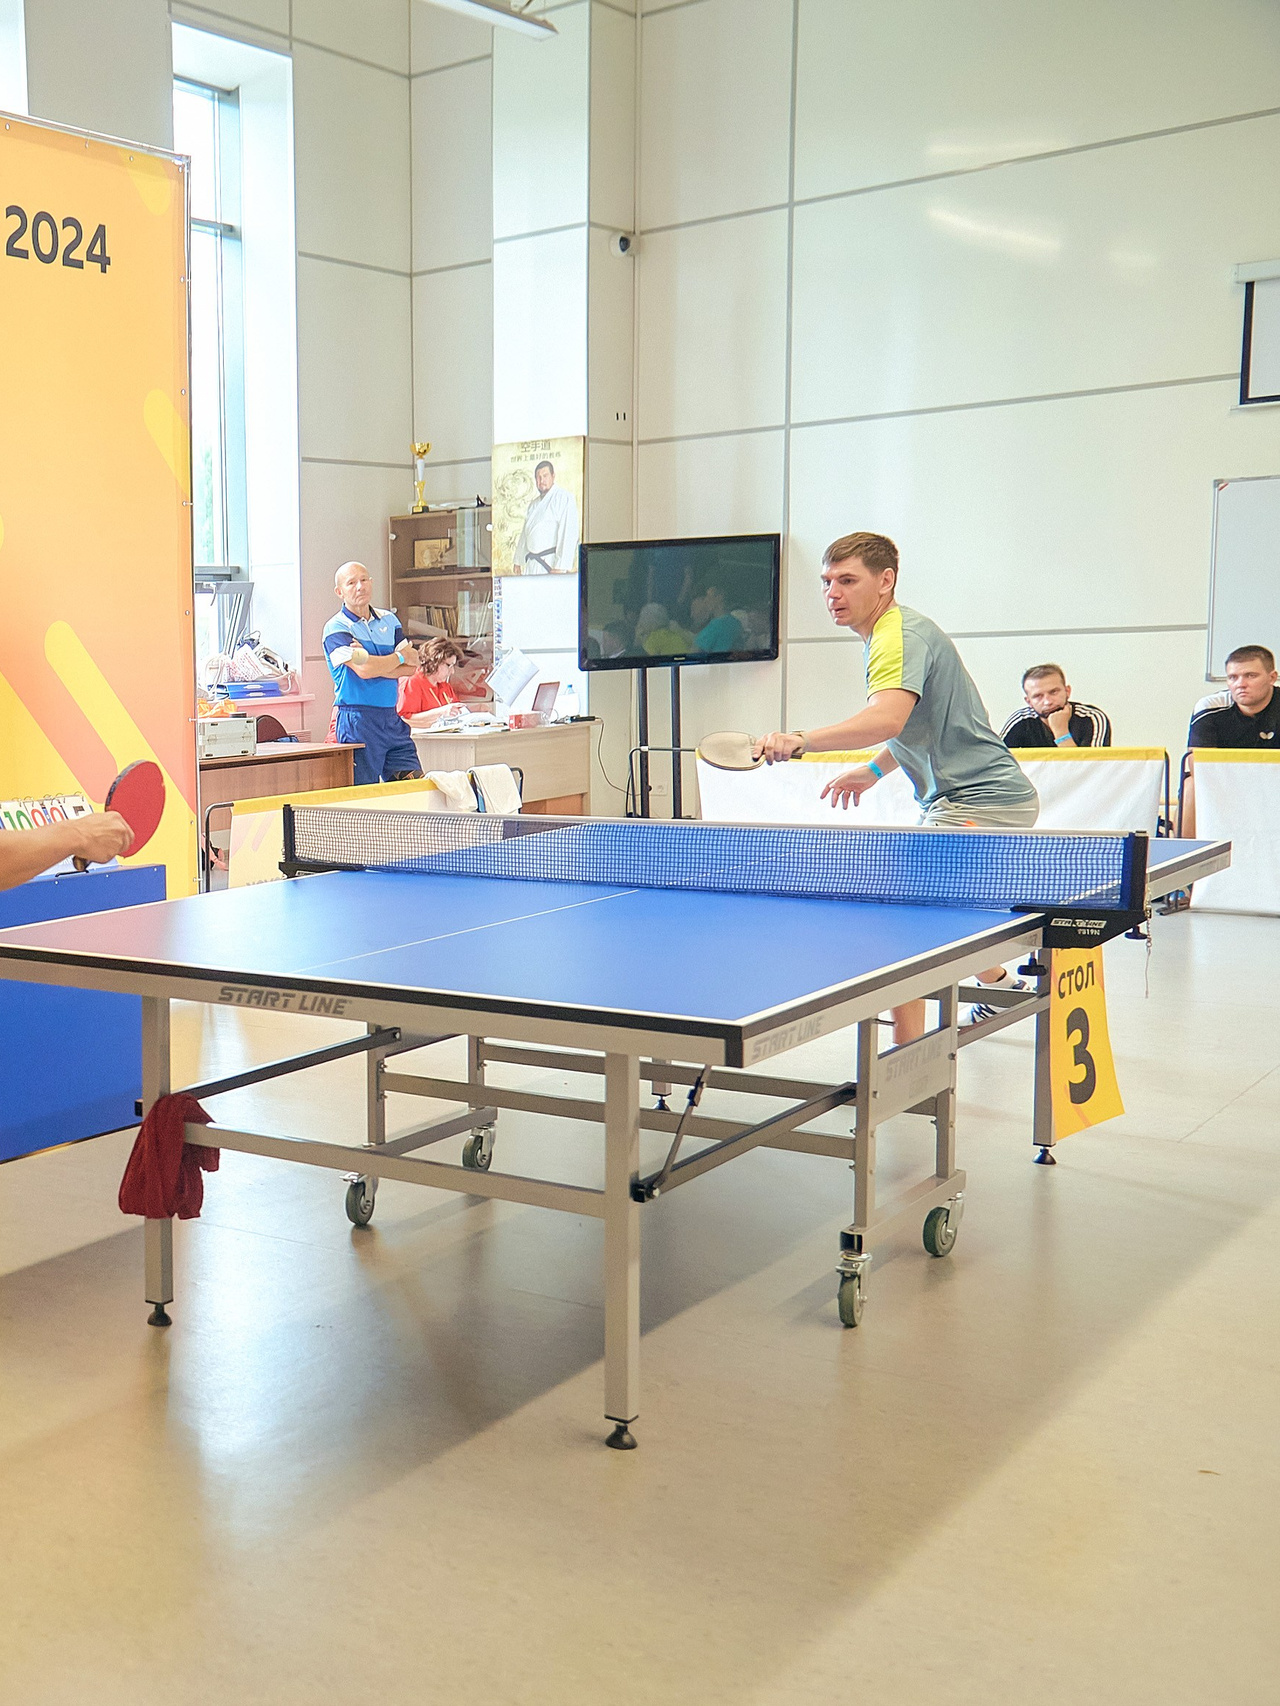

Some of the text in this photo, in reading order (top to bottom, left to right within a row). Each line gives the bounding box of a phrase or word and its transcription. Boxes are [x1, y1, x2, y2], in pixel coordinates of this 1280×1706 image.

[6, 206, 112, 274] 2024
[218, 985, 351, 1016] START LINE
[1058, 961, 1095, 999] СТОЛ
[752, 1015, 825, 1061] START LINE
[1066, 1007, 1097, 1105] 3
